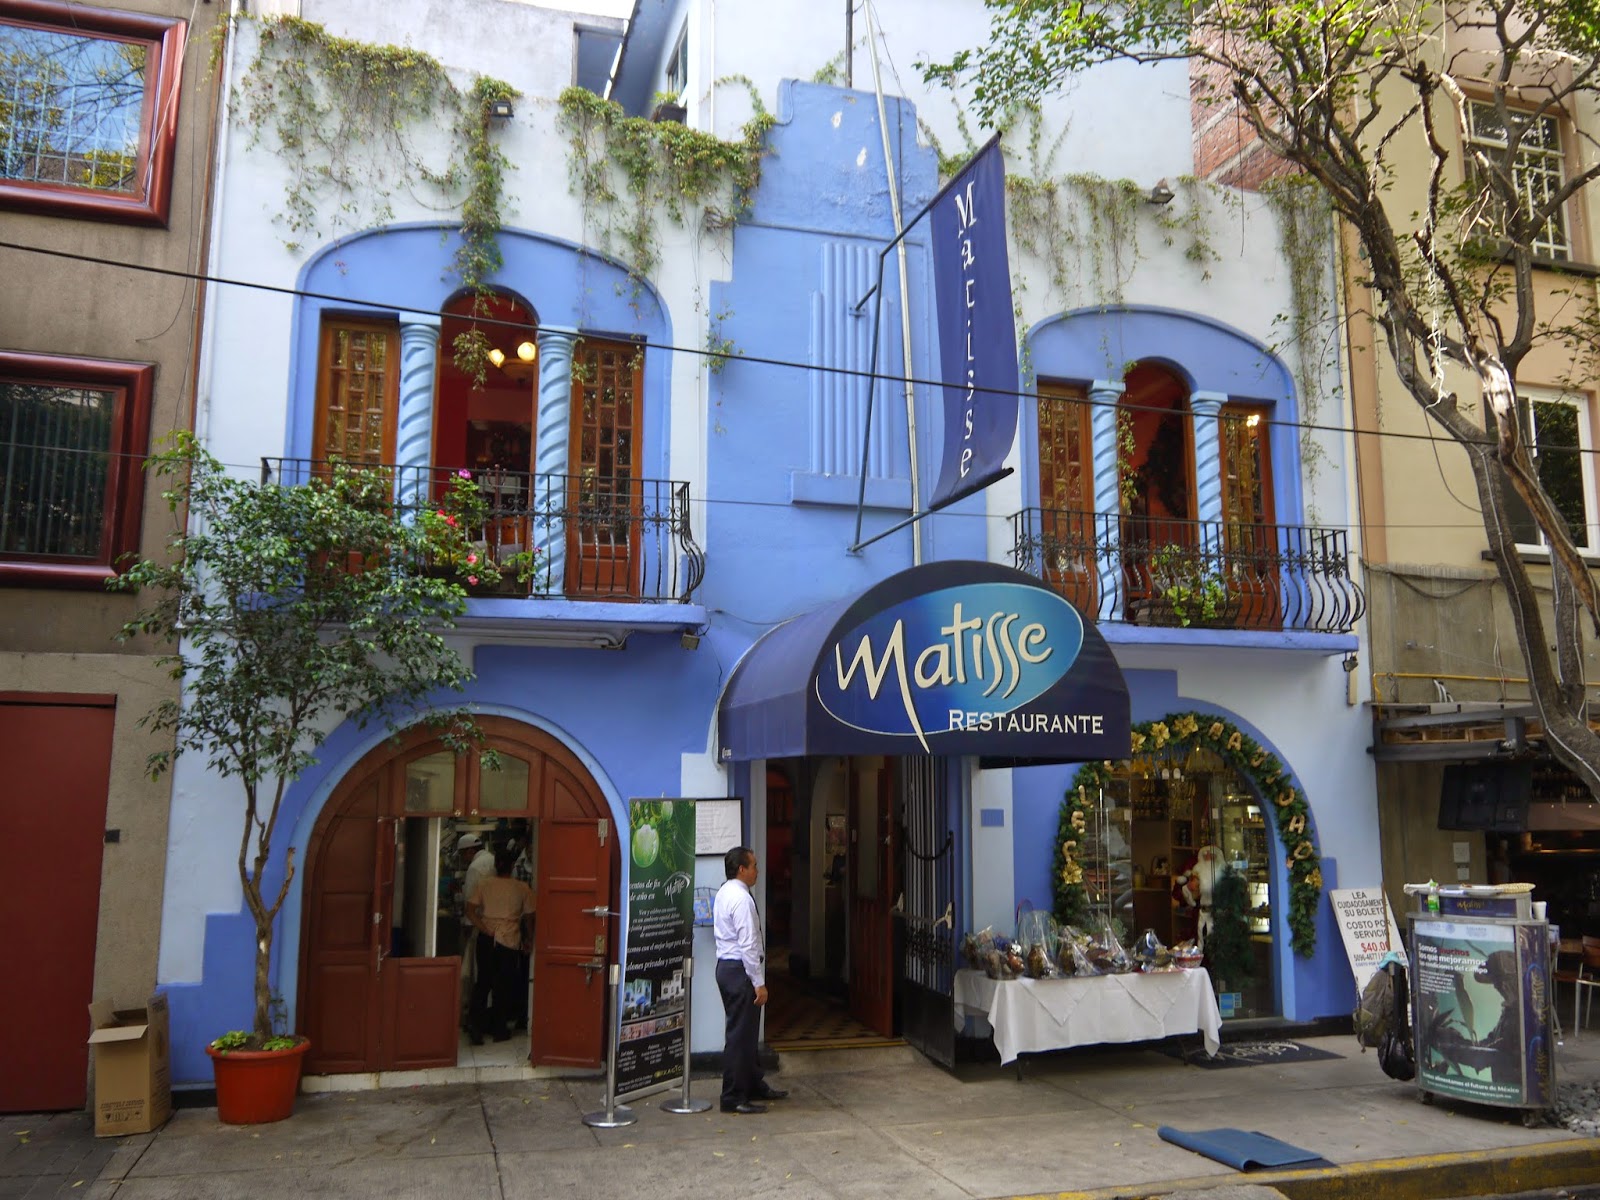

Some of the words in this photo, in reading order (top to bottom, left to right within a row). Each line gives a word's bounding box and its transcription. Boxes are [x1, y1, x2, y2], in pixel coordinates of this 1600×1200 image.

[835, 602, 1053, 754] Matisse
[948, 709, 1104, 735] RESTAURANTE
[1352, 891, 1367, 899] LEA
[1337, 899, 1388, 908] CUIDADOSAMENT
[1344, 909, 1355, 917] SU
[1346, 920, 1373, 930] COSTO
[1440, 947, 1469, 956] muchos
[1439, 954, 1487, 966] mejoramos
[1470, 1081, 1488, 1091] futuro
[1498, 1085, 1520, 1094] México
